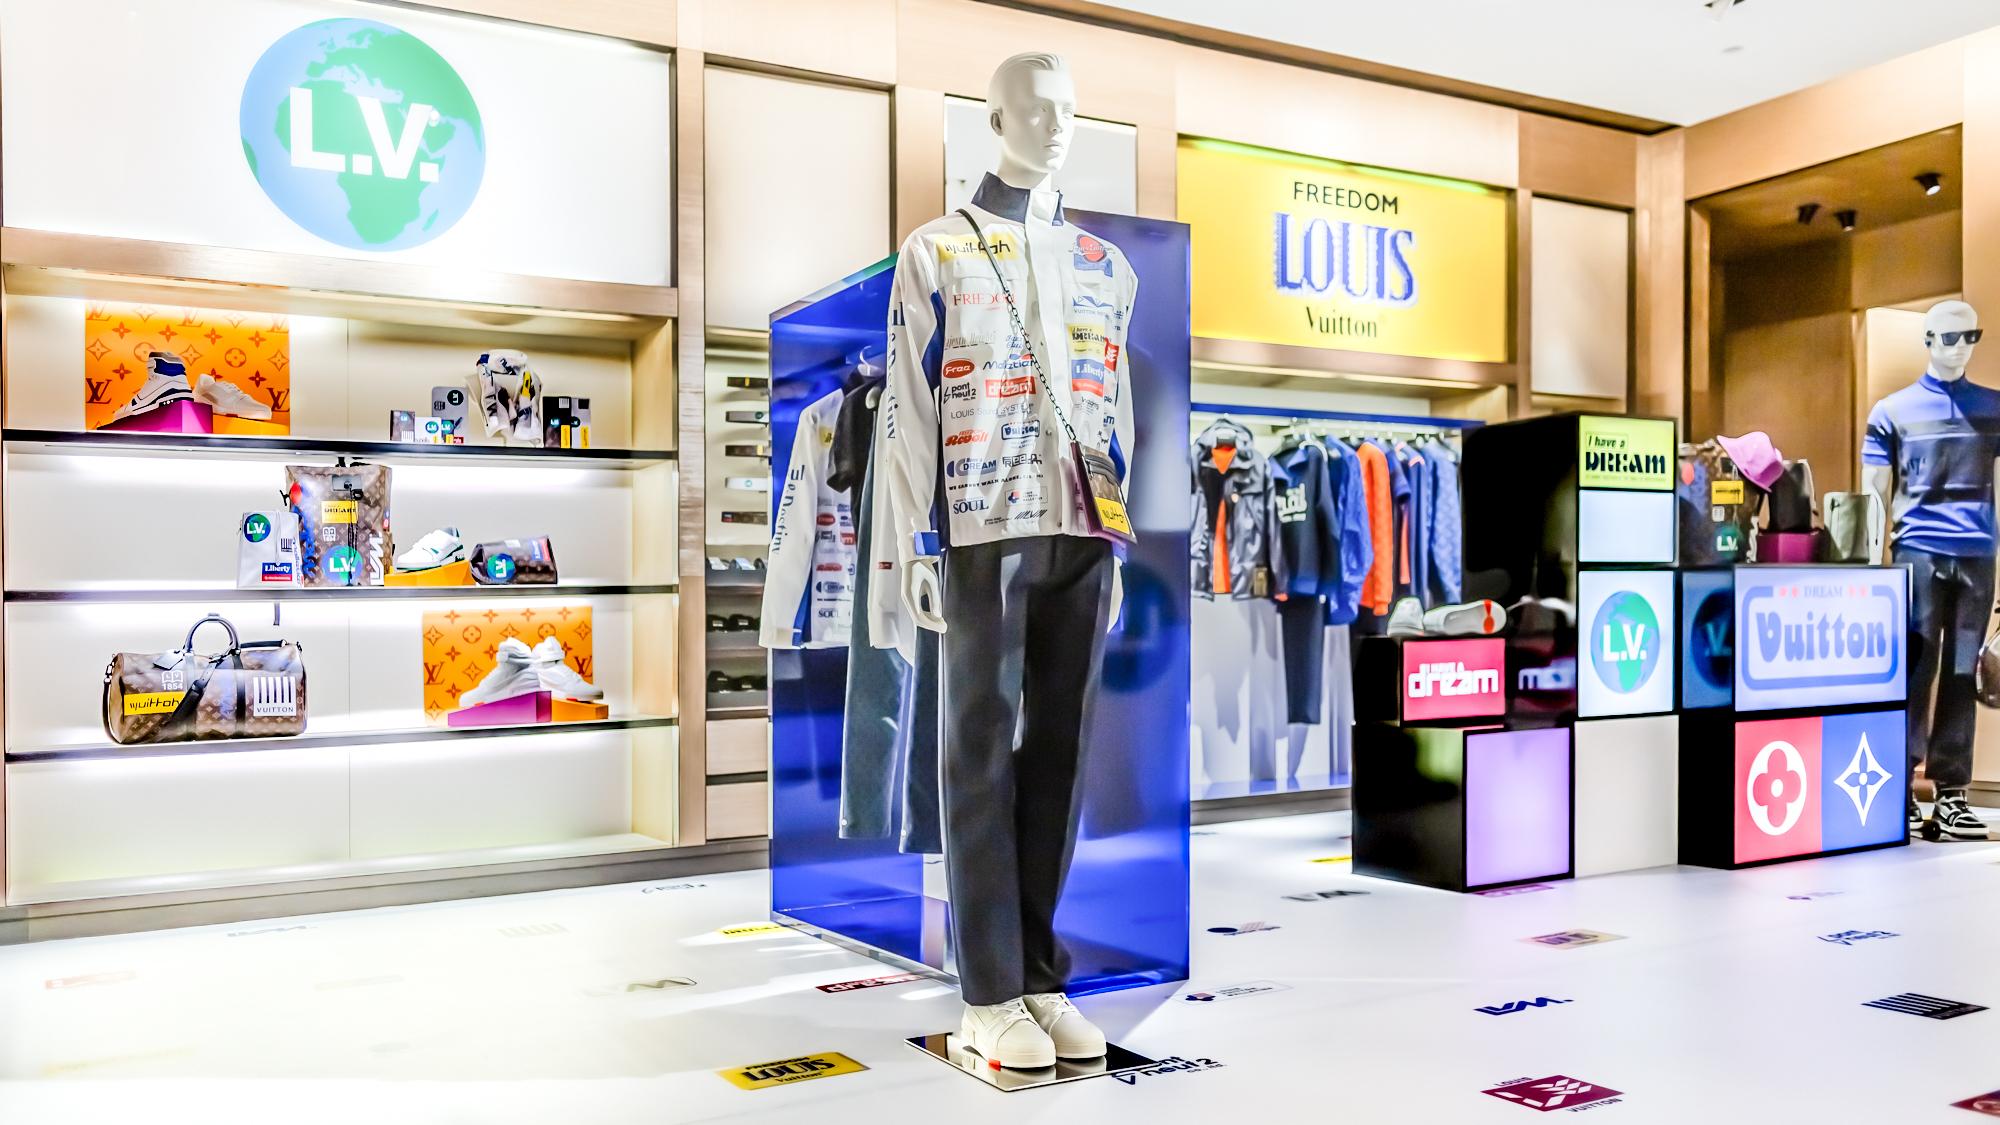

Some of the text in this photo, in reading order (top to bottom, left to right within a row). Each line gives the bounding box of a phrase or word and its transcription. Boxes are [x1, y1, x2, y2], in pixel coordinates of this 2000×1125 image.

[1293, 181, 1399, 215] FREEDOM
[1273, 211, 1416, 302] LOUIS
[1306, 305, 1378, 338] Vuitton
[950, 409, 975, 420] LOUIS
[1588, 435, 1626, 448] I have a
[963, 460, 997, 472] DREAM
[1585, 451, 1666, 475] DREAM
[952, 499, 989, 515] SOUL
[264, 563, 291, 574] Liberty
[1803, 584, 1843, 599] DREAM
[1602, 622, 1648, 663] L.V.
[1755, 610, 1888, 664] Vuitton
[161, 683, 184, 691] 1854
[1408, 664, 1499, 698] dream
[740, 1058, 837, 1082] LOUIS
[774, 1072, 823, 1084] Vuitton
[1493, 1076, 1534, 1088] LOUIS
[1565, 1096, 1624, 1113] VUITTON
